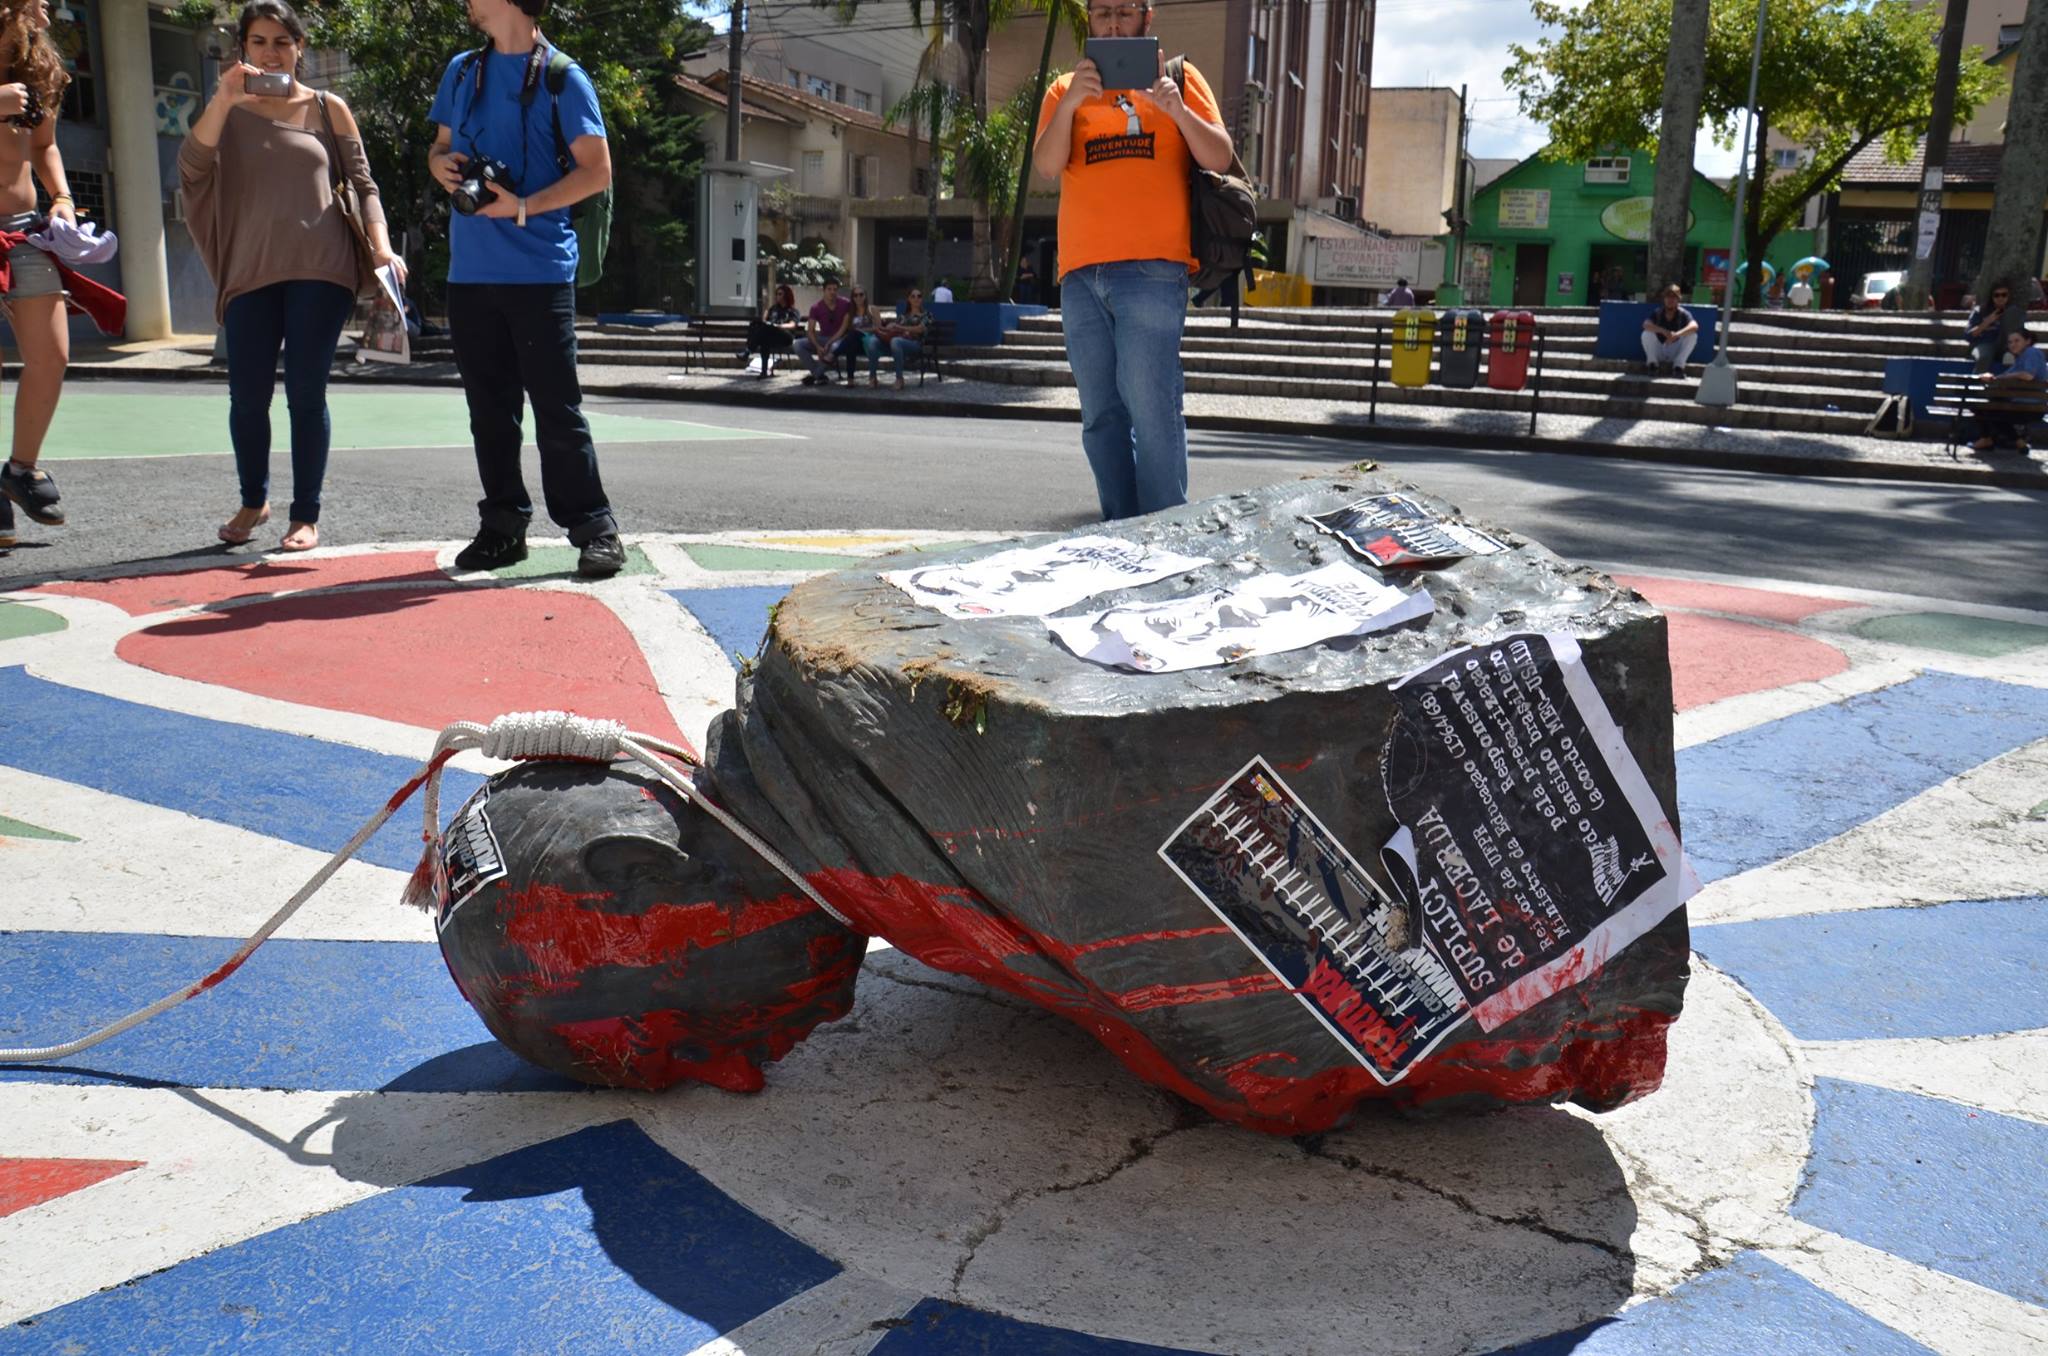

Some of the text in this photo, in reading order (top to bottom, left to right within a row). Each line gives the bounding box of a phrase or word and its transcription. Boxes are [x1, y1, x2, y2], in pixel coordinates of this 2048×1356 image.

[1089, 138, 1152, 153] JUVENTUDE
[1319, 238, 1418, 253] ESTACIONAMENTO
[1332, 252, 1400, 266] CERVANTES
[1485, 647, 1599, 846] do ensino brasileiro
[1556, 733, 1607, 812] (acordo
[1527, 780, 1567, 834] pela
[1503, 835, 1525, 861] da
[1587, 839, 1613, 903] LEVANTE
[1415, 804, 1526, 973] de LACERDA
[1471, 822, 1555, 952] Reitor da UFPR
[1518, 860, 1571, 941] Ministro
[1353, 918, 1372, 936] A
[1364, 929, 1413, 981] CONTRA
[1365, 901, 1466, 1013] HUMANDE
[1416, 874, 1496, 995] SUPLICY
[1298, 954, 1411, 1074] TORTURA
[1405, 973, 1444, 1015] CRIME
